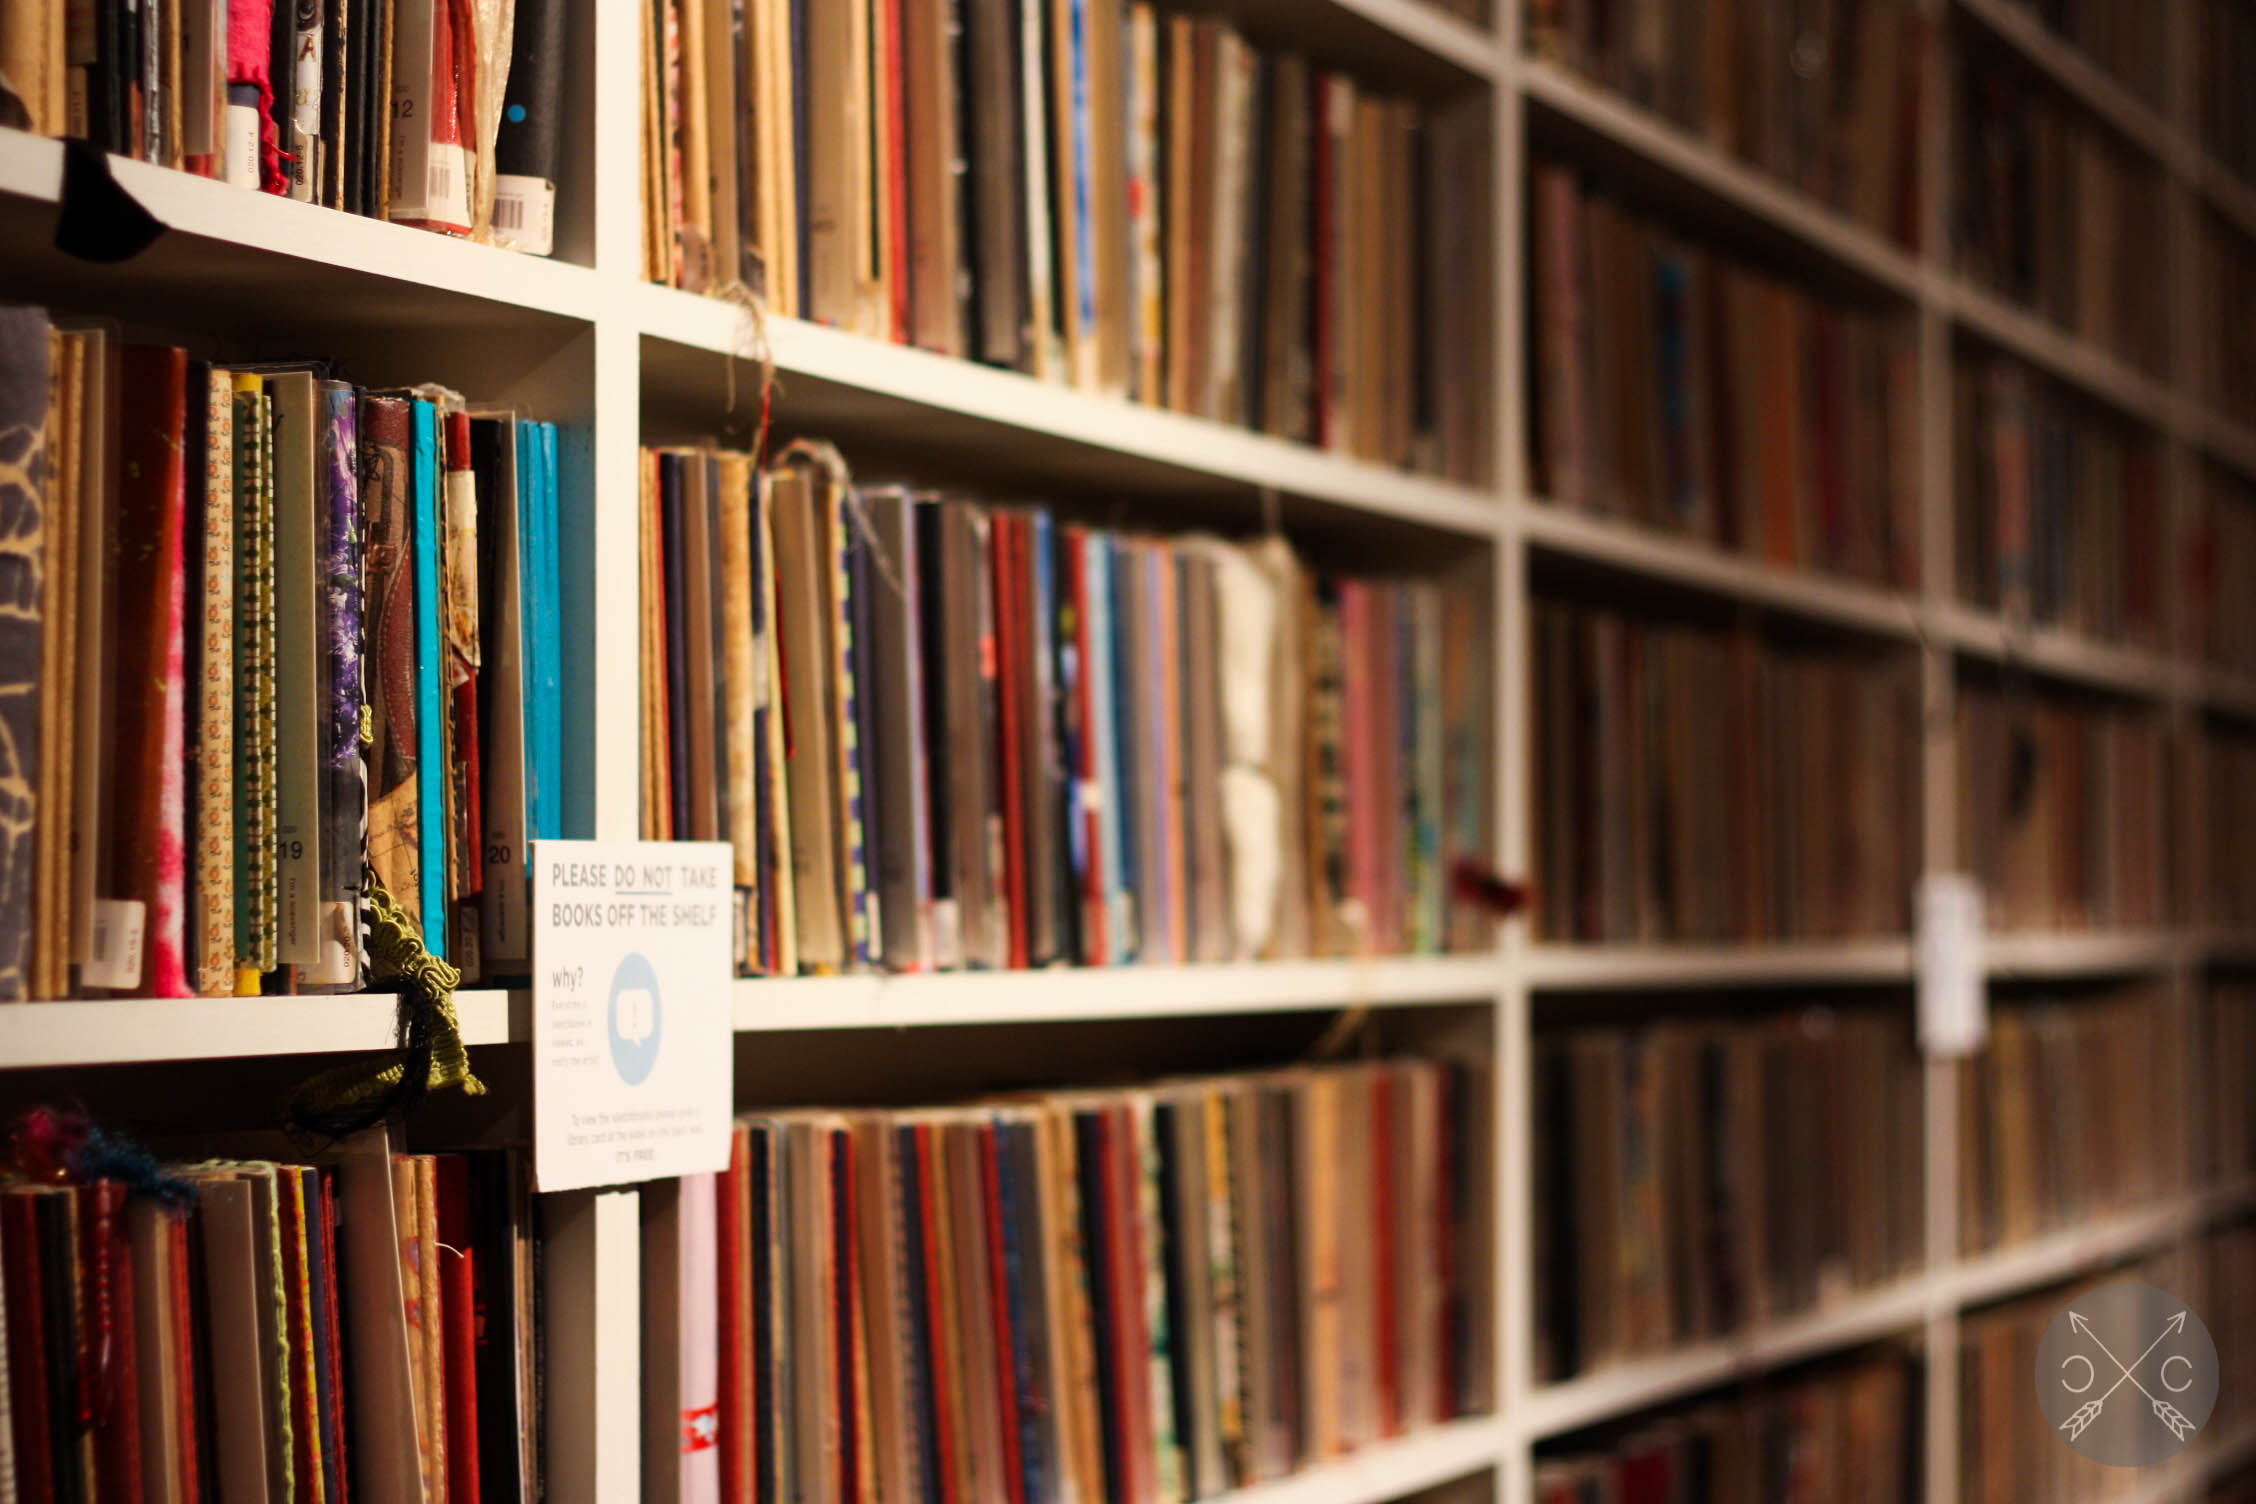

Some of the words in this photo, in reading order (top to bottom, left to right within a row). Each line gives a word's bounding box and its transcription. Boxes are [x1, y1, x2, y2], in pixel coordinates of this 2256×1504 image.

[280, 840, 303, 860] 19
[488, 845, 511, 864] 20
[552, 863, 607, 888] PLEASE
[614, 865, 636, 888] DO
[643, 866, 673, 889] NOT
[681, 866, 719, 889] TAKE
[552, 903, 602, 928] BOOKS
[607, 903, 636, 928] OFF
[639, 904, 667, 927] THE
[672, 904, 717, 927] SHELF
[552, 966, 584, 992] why?
